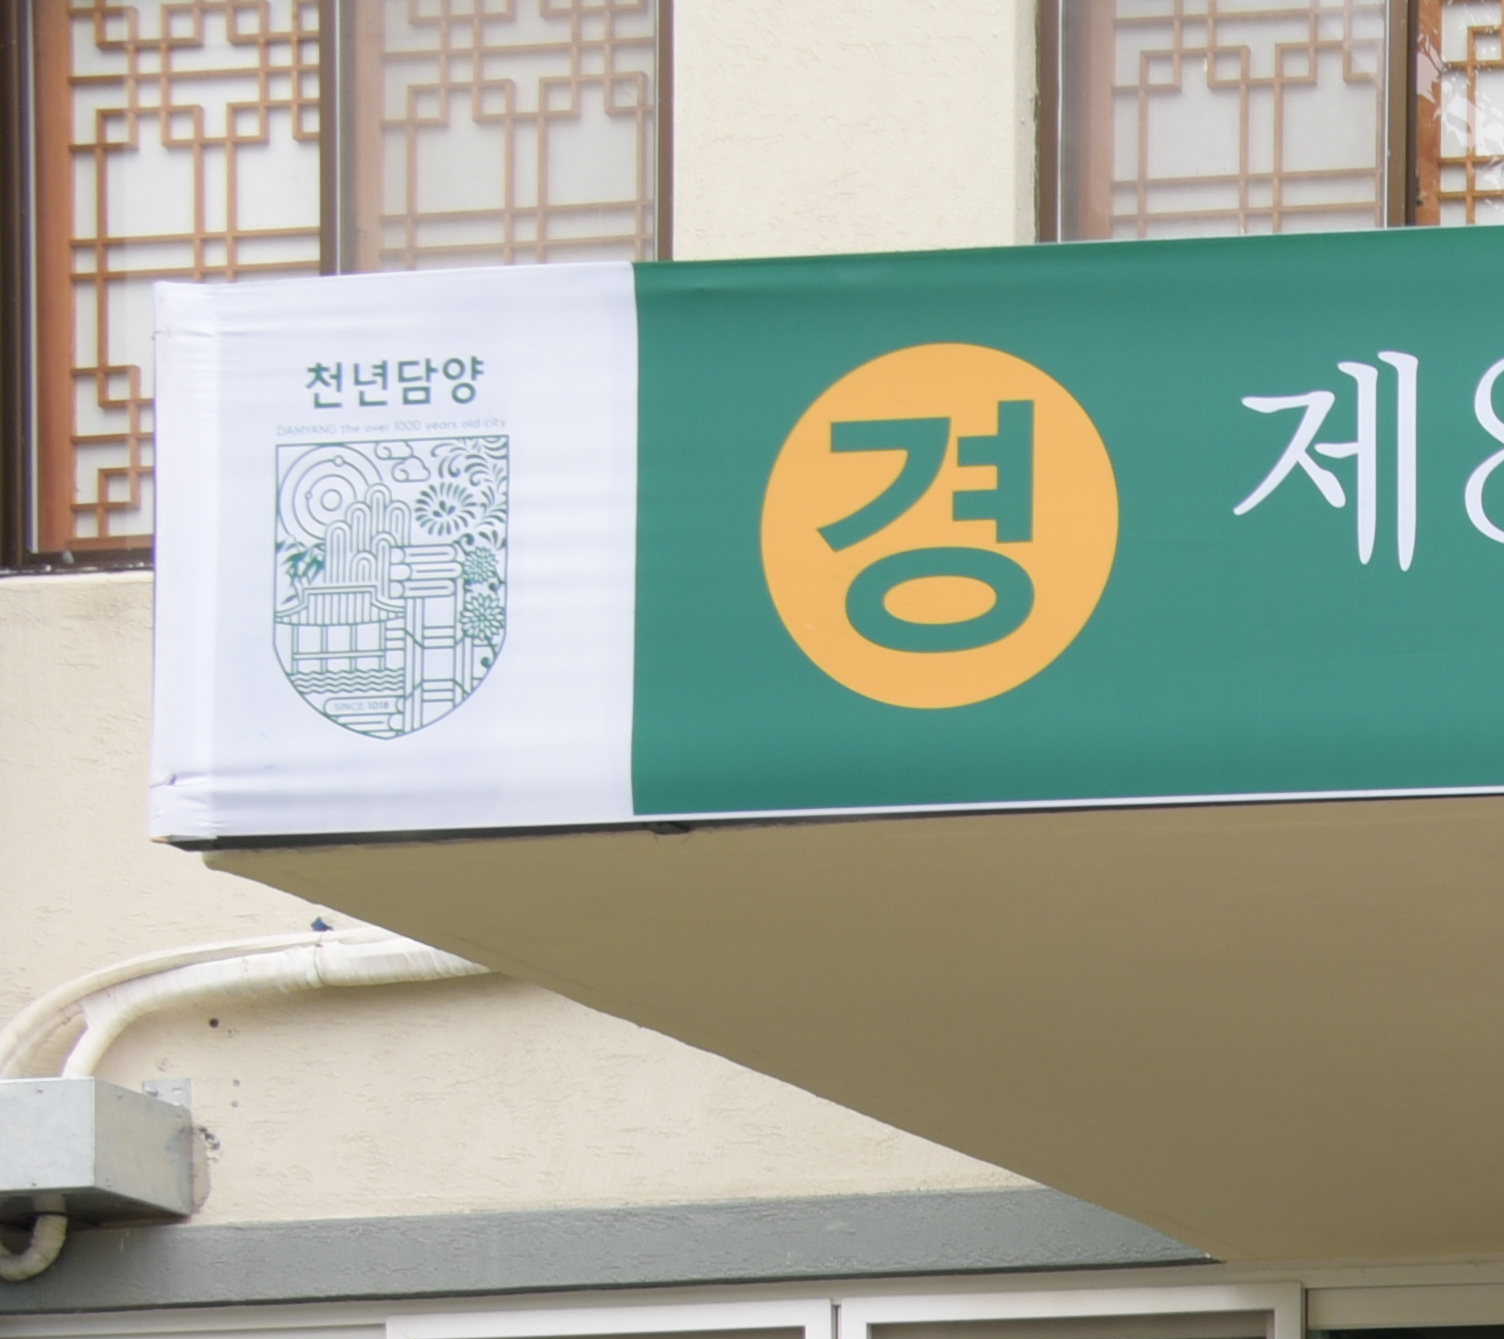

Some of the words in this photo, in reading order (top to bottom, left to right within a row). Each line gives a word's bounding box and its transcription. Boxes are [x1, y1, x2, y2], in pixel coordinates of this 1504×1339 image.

[306, 356, 484, 409] 천년담양
[276, 423, 336, 438] DAMYANG
[340, 423, 362, 435] the
[365, 422, 390, 433] over
[394, 419, 421, 432] 1000
[425, 420, 458, 433] years
[461, 417, 481, 429] old
[484, 416, 507, 430] city
[816, 399, 1036, 653] 경
